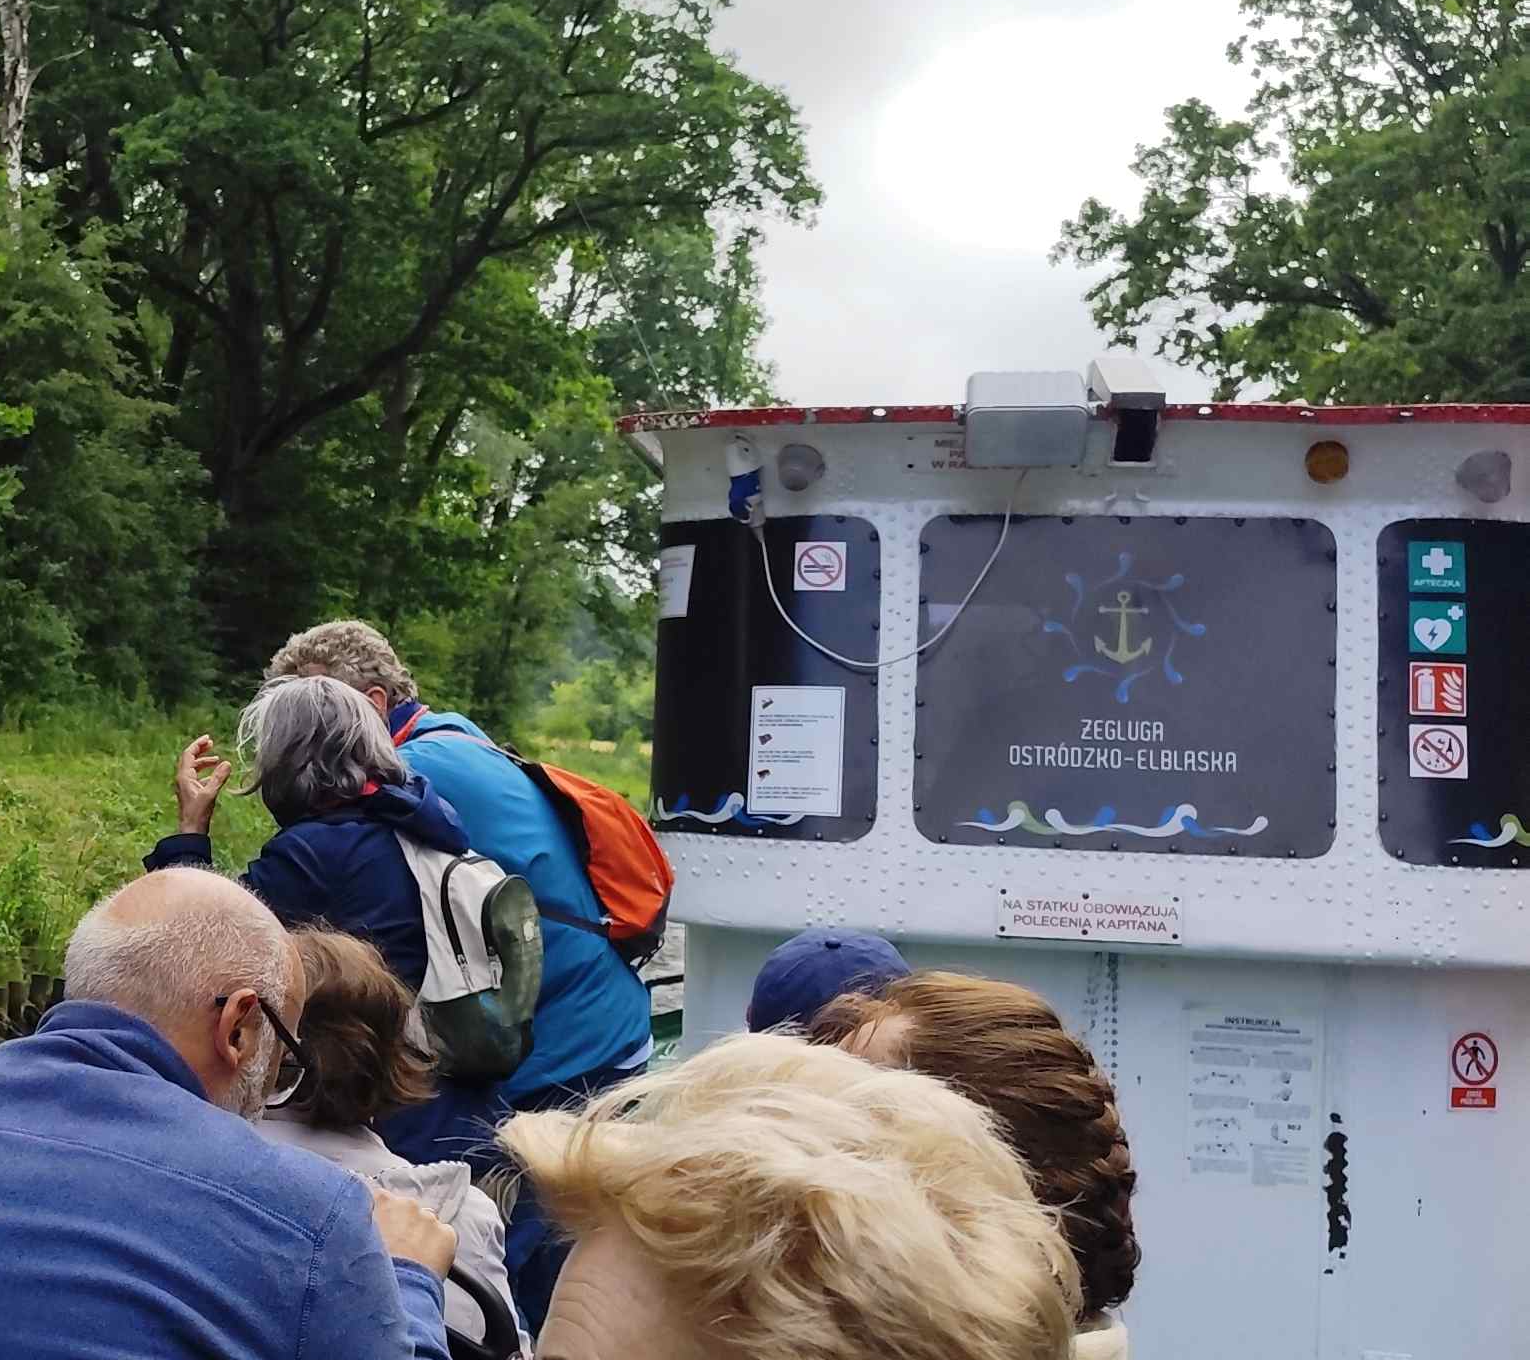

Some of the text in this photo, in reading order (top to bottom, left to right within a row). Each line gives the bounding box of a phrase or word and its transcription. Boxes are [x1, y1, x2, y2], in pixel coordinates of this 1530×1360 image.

[1413, 579, 1461, 588] APTECZKA
[1002, 898, 1179, 921] NA STATKU OBOWIĄZUJĄ
[1013, 914, 1168, 933] POLECENIA KAPITANA
